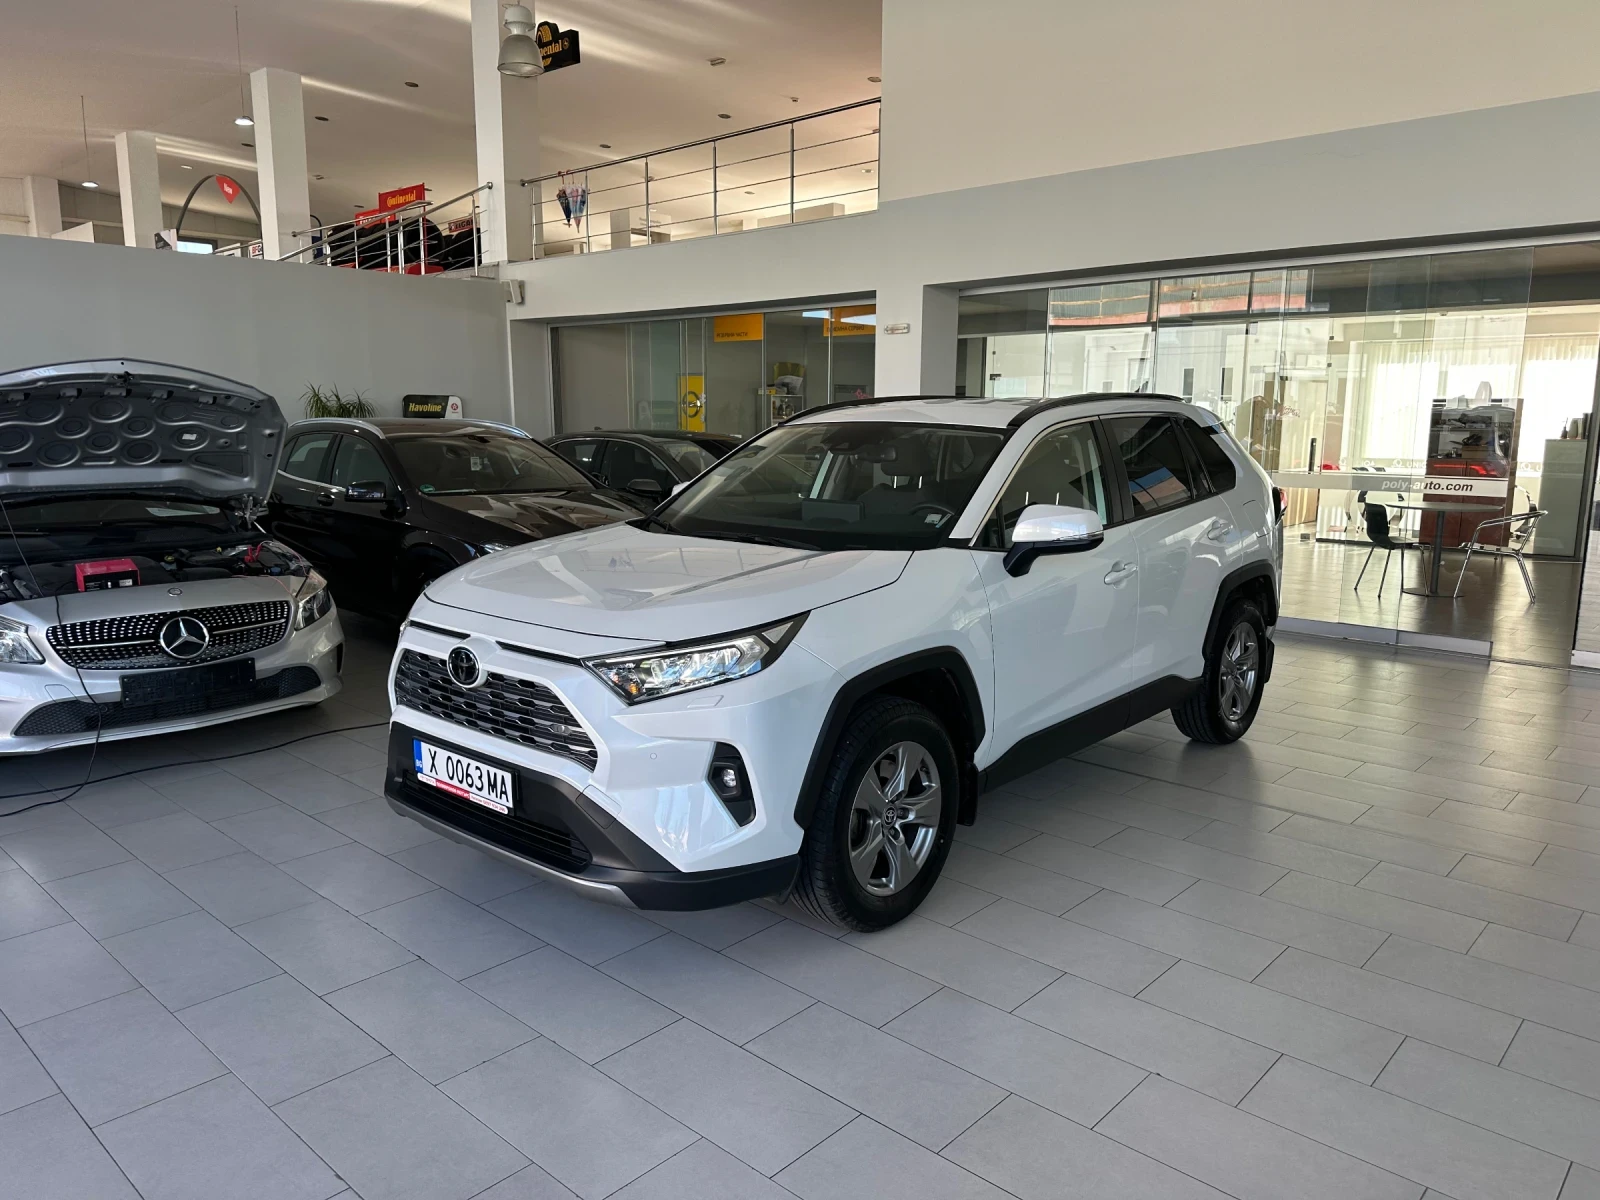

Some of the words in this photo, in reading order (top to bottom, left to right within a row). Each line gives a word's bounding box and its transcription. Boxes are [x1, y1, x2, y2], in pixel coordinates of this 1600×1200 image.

[387, 189, 416, 207] Continental
[408, 402, 442, 412] Havoline
[1381, 480, 1473, 492] poly-auto.com
[428, 748, 438, 776] X
